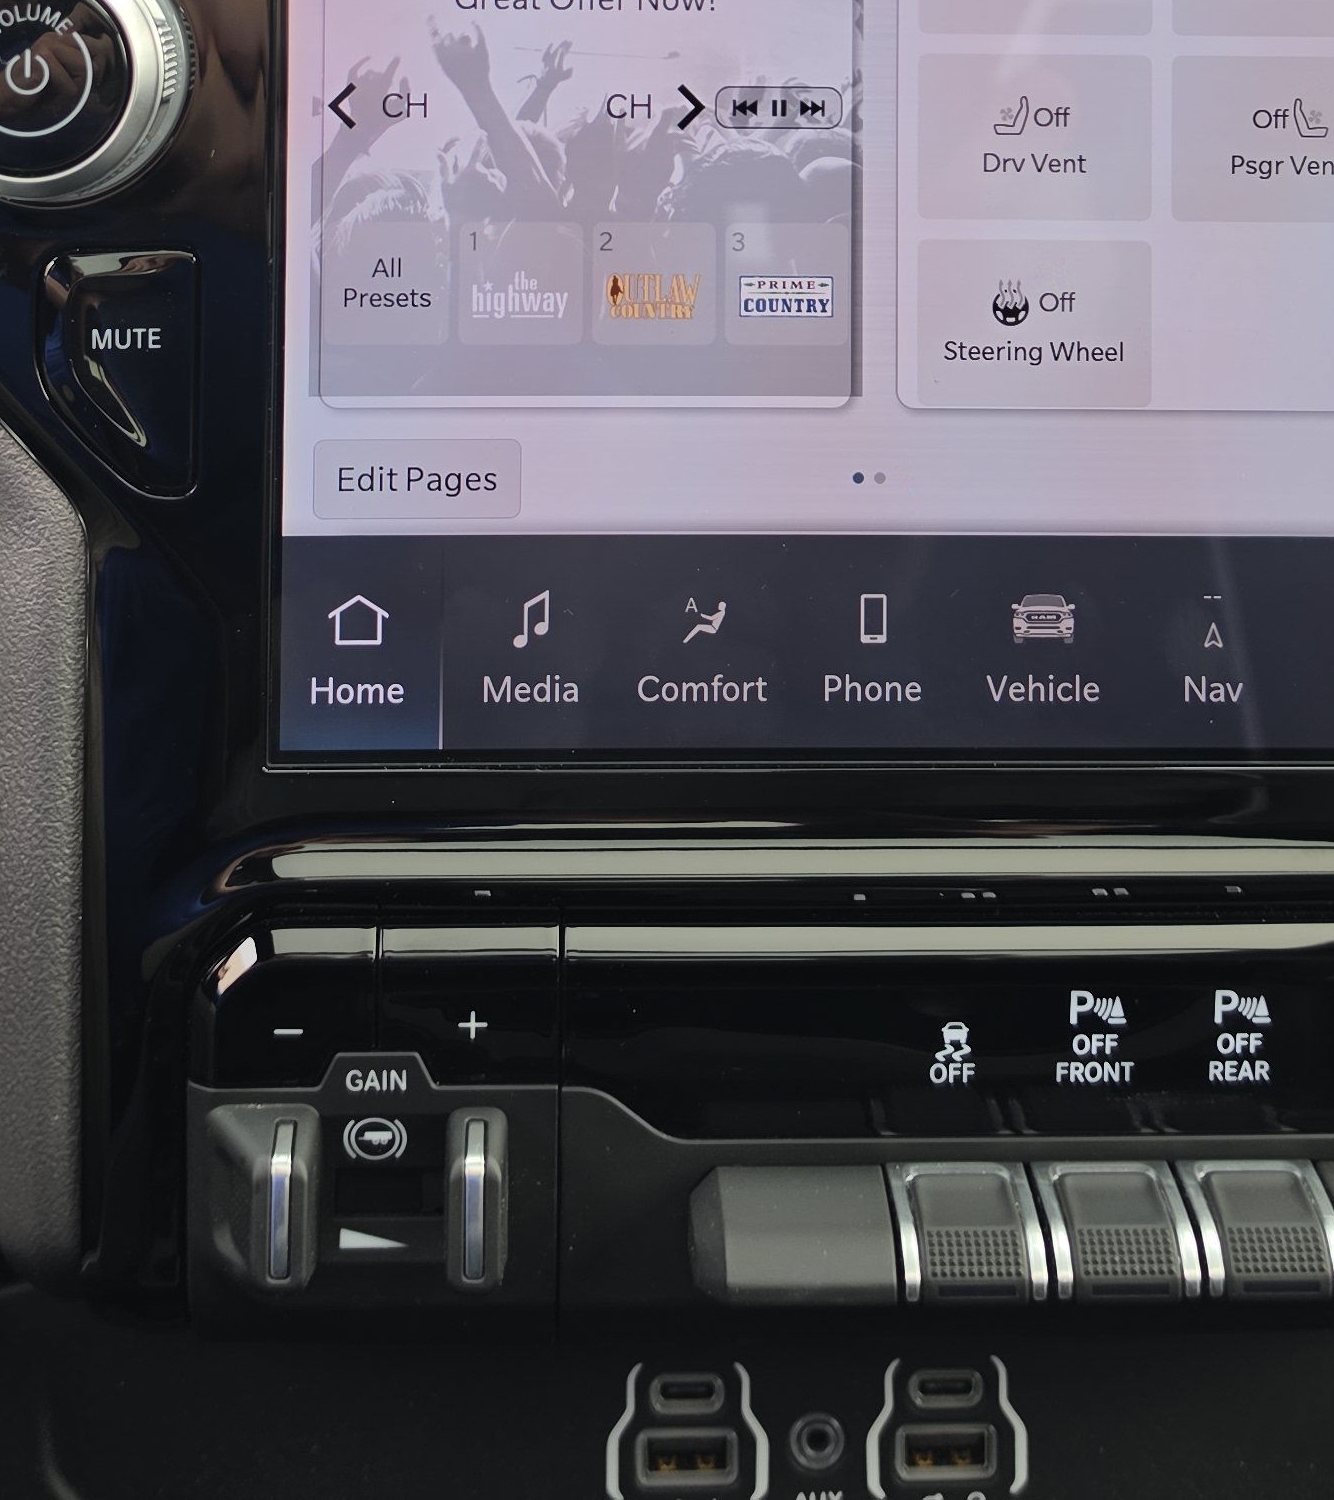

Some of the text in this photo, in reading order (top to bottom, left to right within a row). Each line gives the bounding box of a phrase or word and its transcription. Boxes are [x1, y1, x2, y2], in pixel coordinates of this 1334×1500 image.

[382, 92, 428, 119] CH
[606, 93, 652, 120] CH
[1033, 106, 1071, 128] Off
[1252, 108, 1290, 129] Off
[983, 152, 1087, 174] Drv Vent
[1231, 154, 1285, 180] Psgr
[469, 232, 477, 252] 1
[600, 231, 613, 252] 2
[731, 231, 745, 252] 3
[371, 257, 402, 278] All
[514, 270, 539, 290] the
[757, 280, 816, 290] PRIME
[343, 287, 432, 308] Presets
[472, 283, 569, 318] highway
[743, 297, 831, 314] COUNTRY
[1038, 291, 1076, 313] Off
[610, 301, 695, 320] COUNTRY
[91, 328, 162, 351] MUTE
[943, 340, 1124, 366] Steering Wheel
[338, 465, 497, 498] Edit Pages
[310, 676, 405, 705] Home
[483, 674, 579, 703] Media
[637, 673, 768, 703] Comfort
[824, 673, 922, 702] Phone
[986, 673, 1100, 702] Vehicle
[1184, 675, 1244, 703] Nav
[1073, 1033, 1119, 1055] OFF
[1217, 1033, 1264, 1054] OFF
[345, 1069, 407, 1092] GAIN
[929, 1062, 976, 1083] OFF
[1055, 1061, 1135, 1083] FRONT
[1208, 1060, 1270, 1081] REAR
